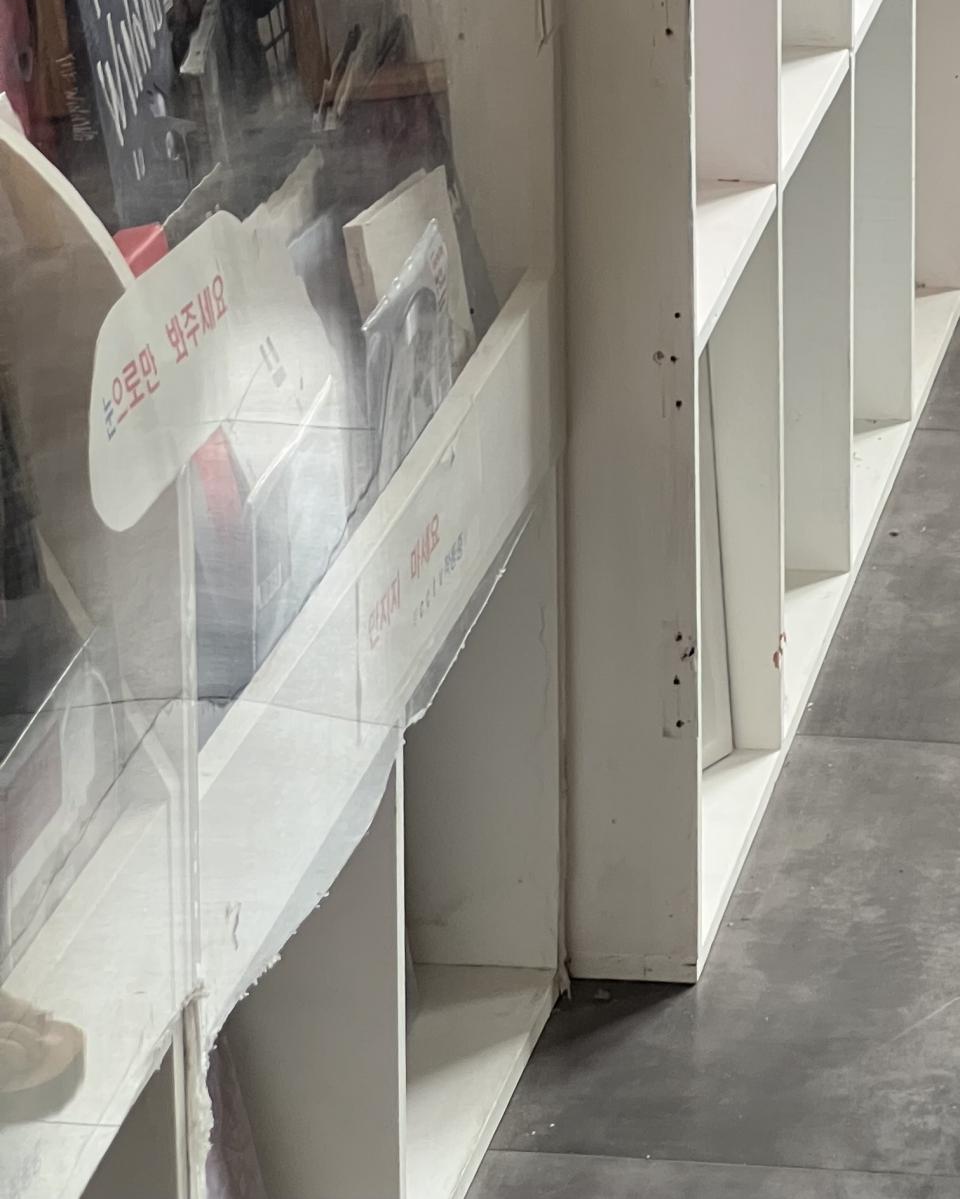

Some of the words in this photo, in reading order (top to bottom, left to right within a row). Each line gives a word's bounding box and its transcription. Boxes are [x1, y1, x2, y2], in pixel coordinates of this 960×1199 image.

[102, 342, 161, 441] 눈으로만
[165, 274, 229, 365] 봐주세요
[410, 513, 441, 581] 마세요
